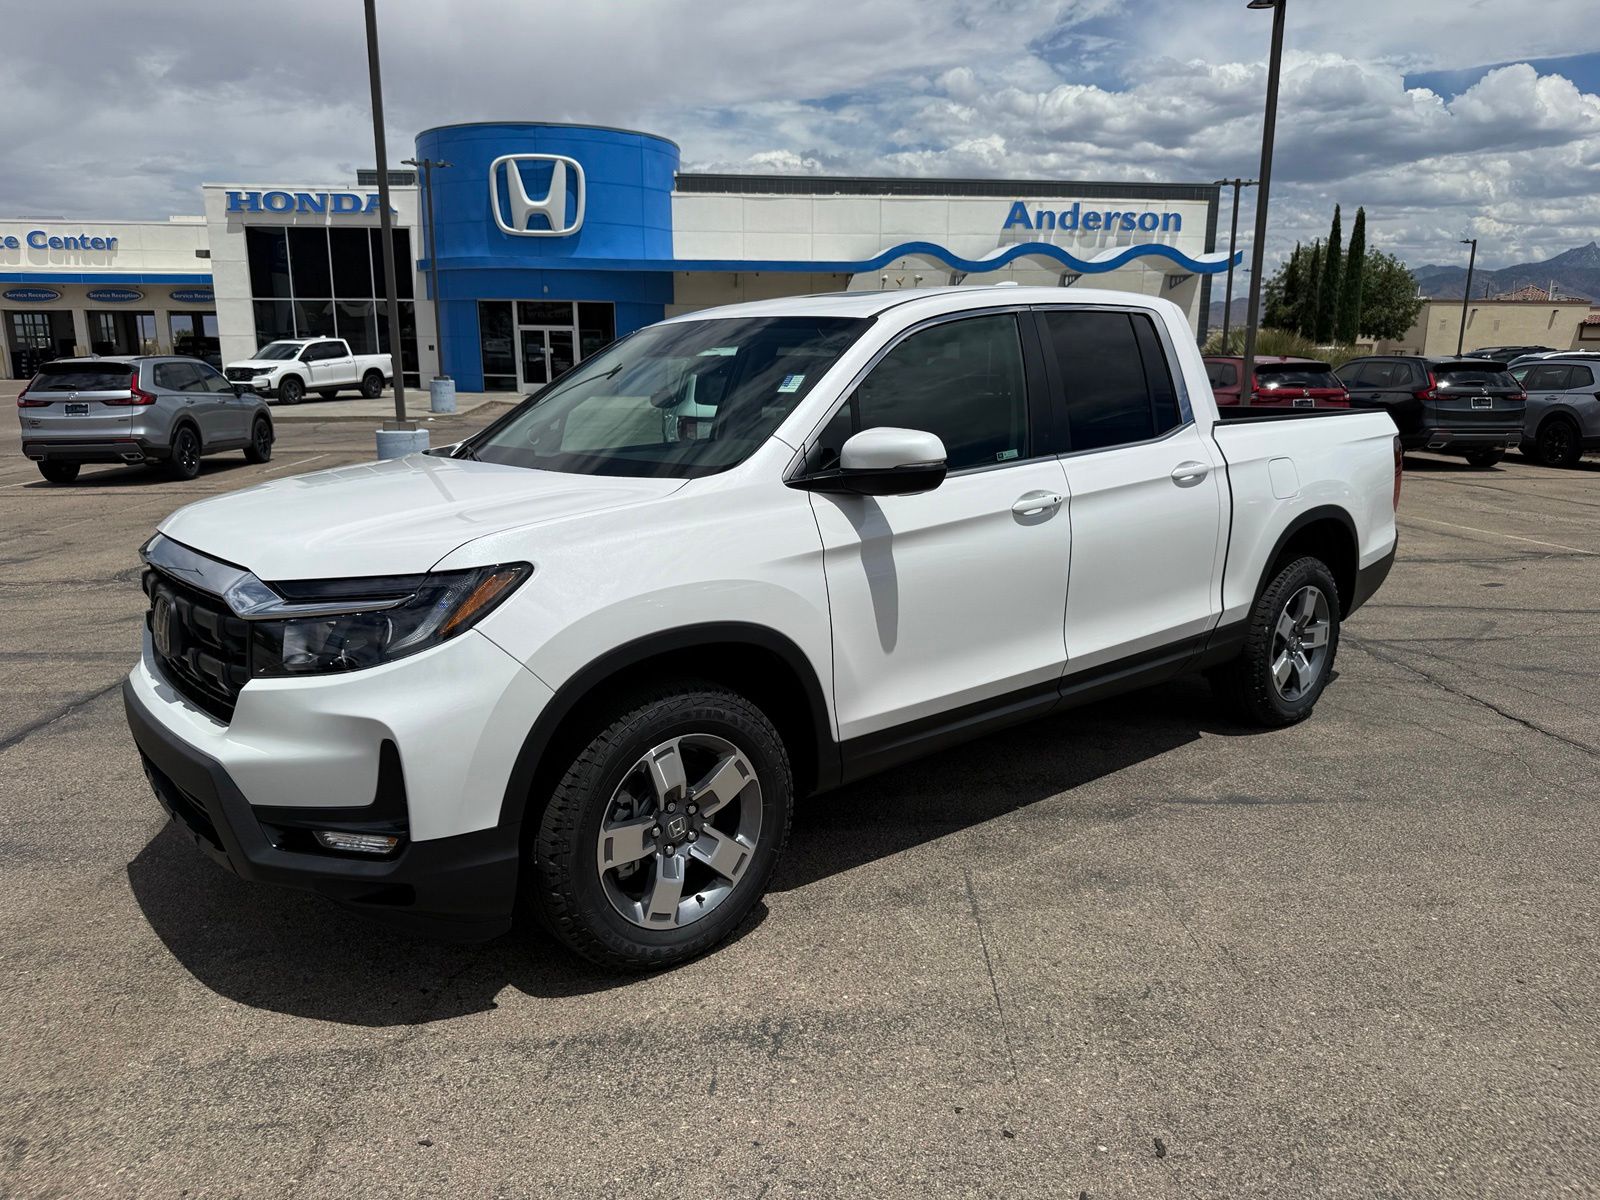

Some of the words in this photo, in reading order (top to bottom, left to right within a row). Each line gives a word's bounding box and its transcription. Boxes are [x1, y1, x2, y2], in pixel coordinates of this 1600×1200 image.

[225, 191, 398, 213] HONDA
[1003, 201, 1182, 231] Anderson
[26, 230, 118, 250] Center
[111, 292, 140, 300] Reception
